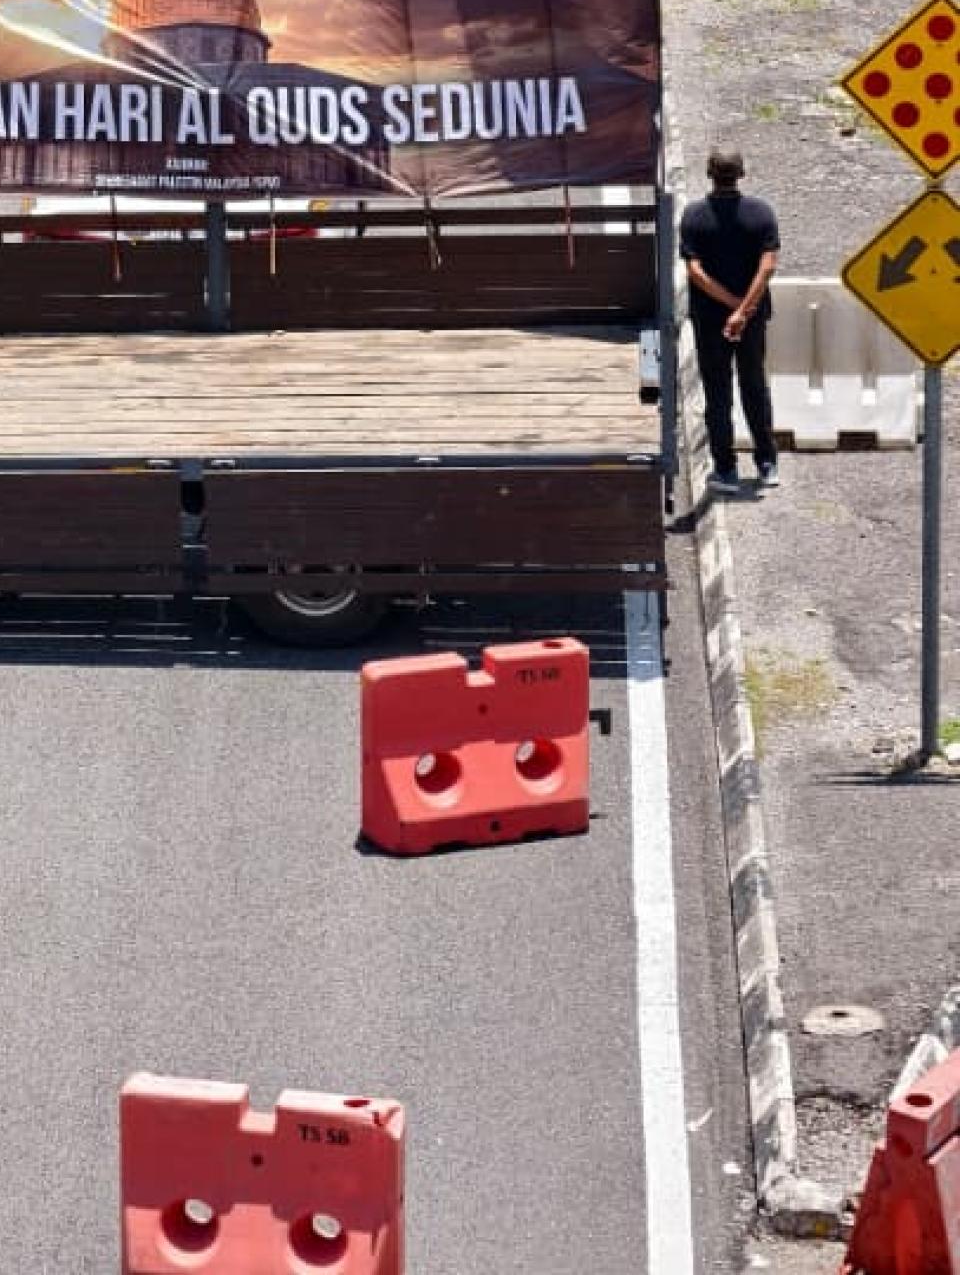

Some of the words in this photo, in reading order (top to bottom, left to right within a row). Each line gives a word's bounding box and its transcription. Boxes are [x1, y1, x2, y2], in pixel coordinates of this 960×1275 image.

[53, 82, 163, 143] HARI
[176, 86, 236, 145] AL
[245, 85, 368, 148] QUDS
[381, 76, 588, 144] SEDUNIA
